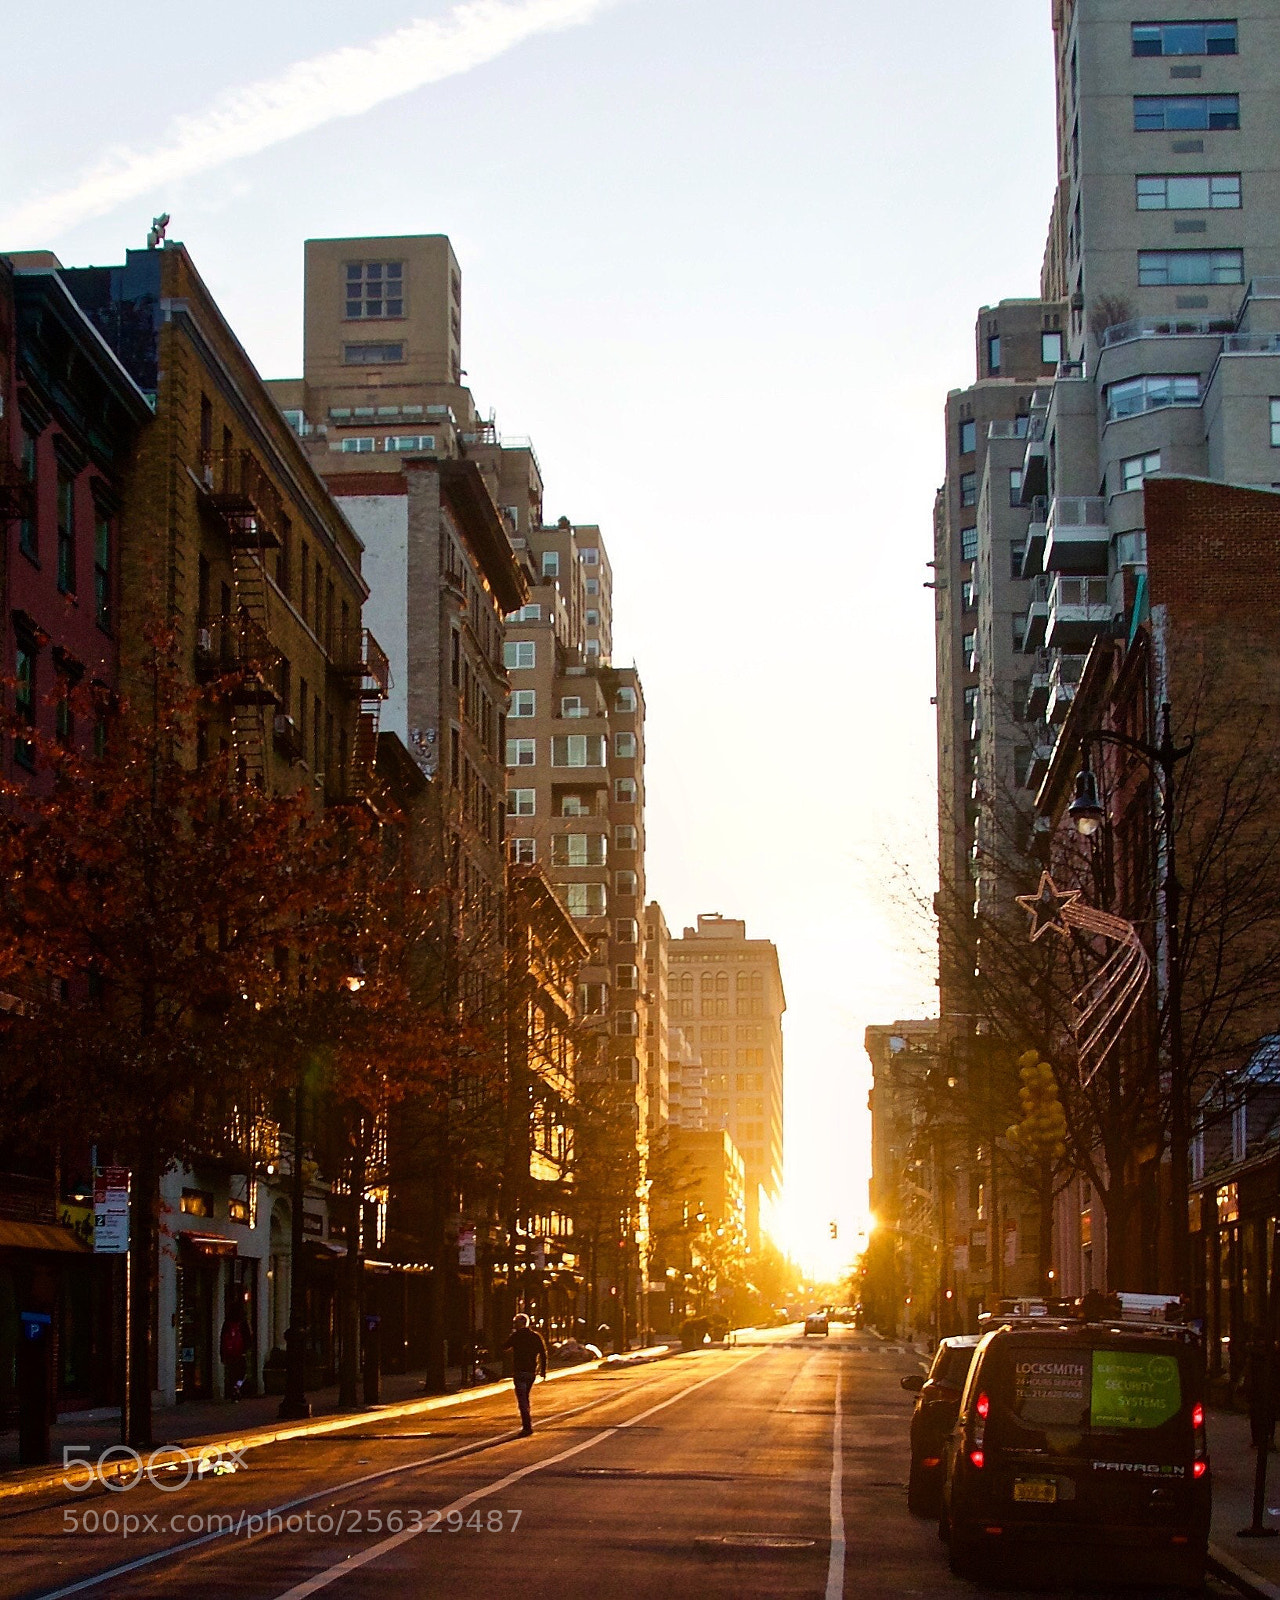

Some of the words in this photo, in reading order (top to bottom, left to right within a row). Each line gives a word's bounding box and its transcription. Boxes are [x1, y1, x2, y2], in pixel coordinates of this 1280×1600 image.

[97, 1216, 104, 1226] 2
[30, 1323, 40, 1338] P
[1015, 1362, 1084, 1376] LOCKSMITH
[1105, 1379, 1155, 1392] SECURITY
[1118, 1396, 1167, 1409] SYSTEMS
[1093, 1462, 1185, 1474] PARAGON
